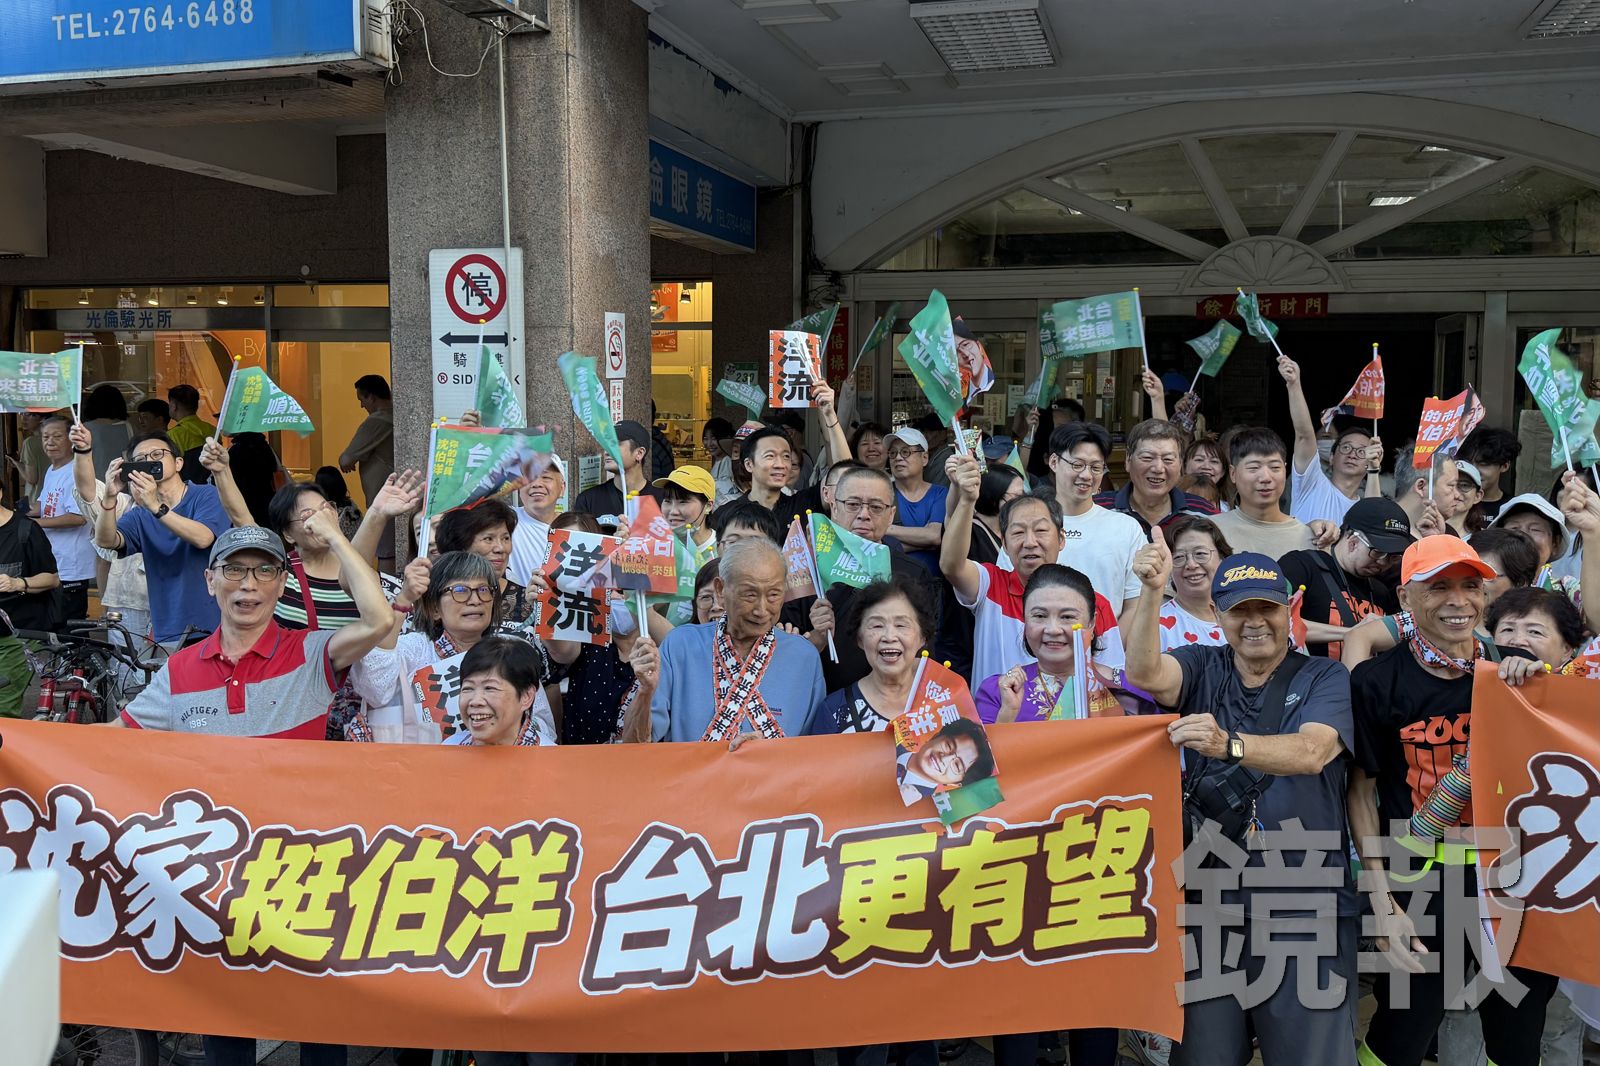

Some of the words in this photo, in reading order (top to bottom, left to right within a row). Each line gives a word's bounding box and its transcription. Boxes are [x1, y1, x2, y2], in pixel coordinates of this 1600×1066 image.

[462, 272, 492, 306] 停
[87, 310, 172, 329] 光倫驗光所
[261, 415, 298, 425] FUTURE
[433, 438, 449, 477] 沈伯洋
[547, 540, 606, 635] 洋流
[1219, 564, 1278, 588] Titleist
[180, 705, 219, 724] HILFIGER
[1400, 713, 1471, 744] SOO
[0, 793, 569, 974] 沈家挺伯洋
[590, 805, 1152, 981] 台北更有望
